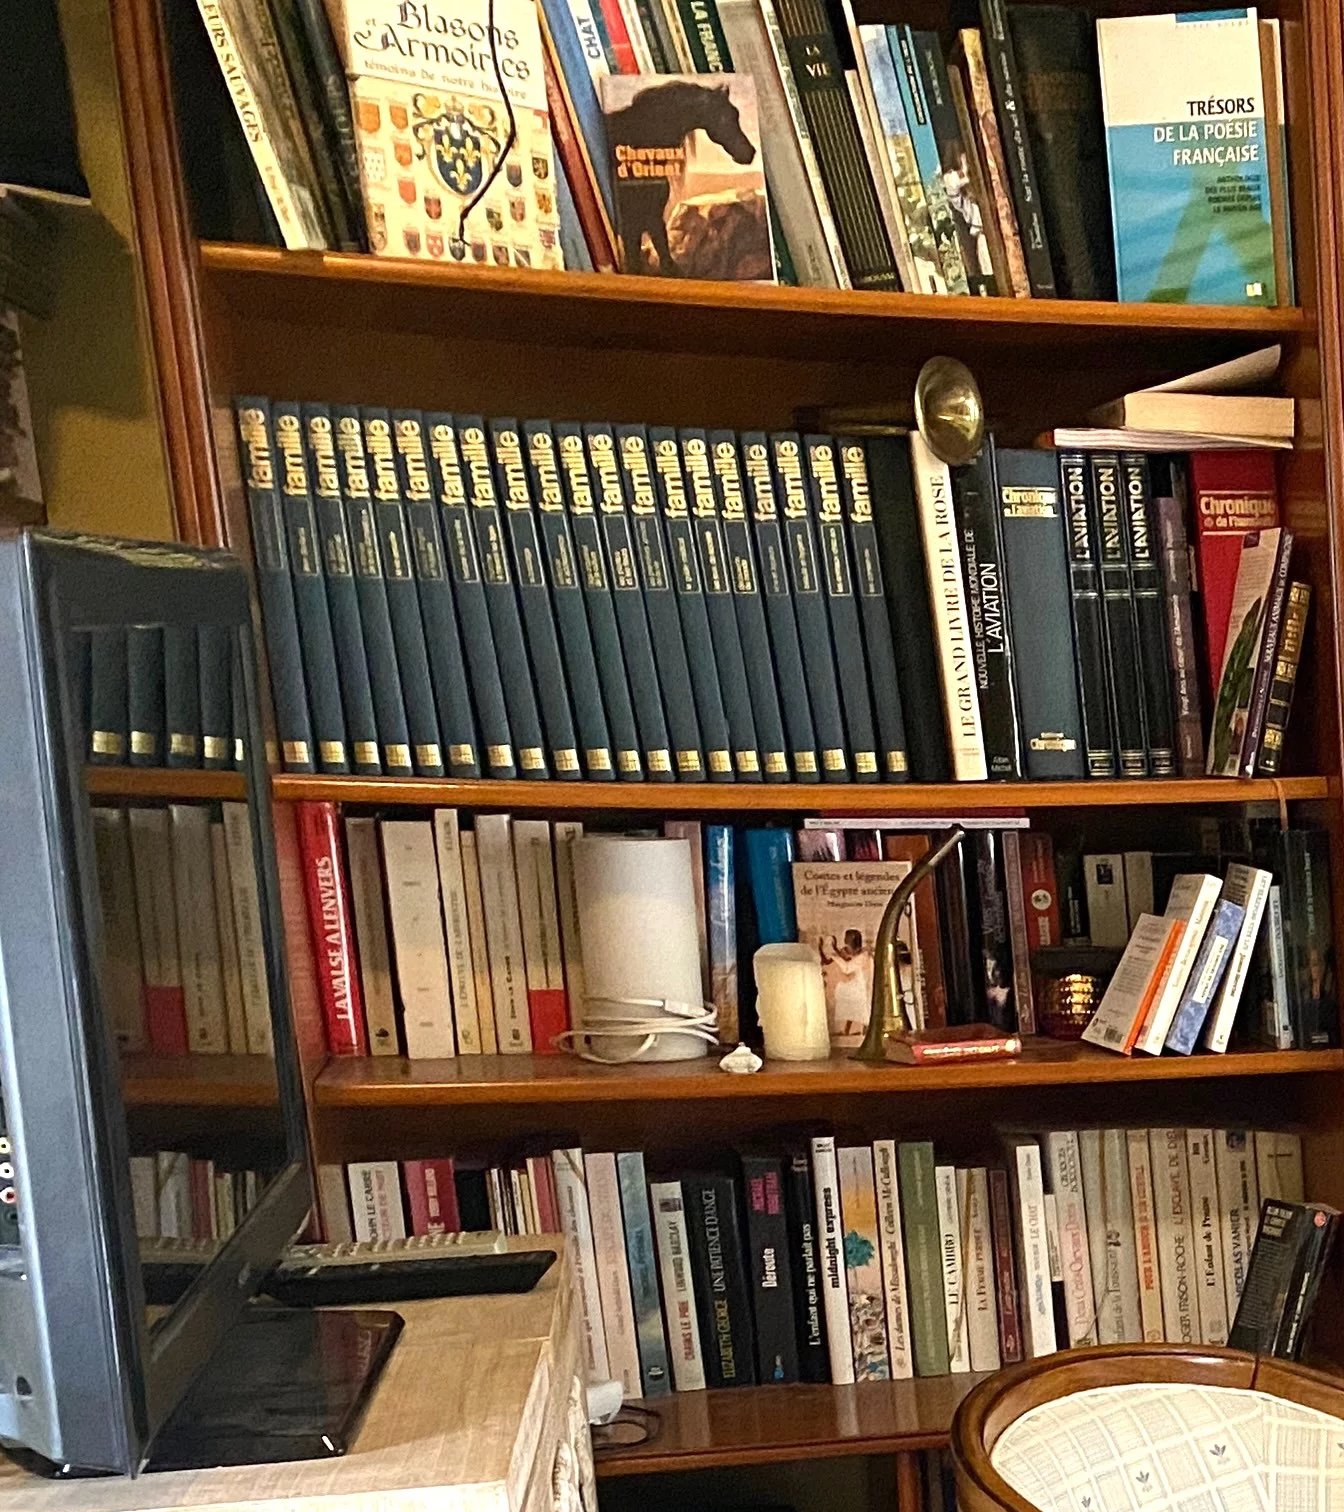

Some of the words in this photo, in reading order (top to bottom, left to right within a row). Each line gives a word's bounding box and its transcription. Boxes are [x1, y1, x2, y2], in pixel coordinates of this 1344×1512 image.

[397, 0, 519, 50] Blasons
[577, 16, 600, 60] CHAT
[1154, 124, 1175, 142] DE
[1179, 123, 1200, 141] LA
[1204, 118, 1258, 141] POÉSIE
[1187, 98, 1255, 116] TRÉSORS
[615, 145, 685, 161] Chevaux
[617, 161, 683, 180] d'Orient
[1173, 146, 1260, 169] FRANÇAISE
[238, 408, 274, 489] famille
[275, 415, 308, 495] famille
[308, 416, 340, 498] famille
[337, 417, 370, 499] famille
[366, 419, 399, 501] famille
[395, 419, 431, 501] famille
[430, 424, 465, 505] famille
[462, 428, 496, 508] famille
[496, 431, 531, 511] famille
[529, 432, 564, 512] famille
[591, 434, 624, 513] famille
[560, 436, 593, 515] famille
[623, 436, 655, 514] famille
[656, 440, 688, 518] famille
[684, 439, 716, 518] famille
[712, 442, 745, 520] famille
[744, 444, 777, 521] famille
[778, 441, 808, 518] famille
[811, 445, 841, 522] famille
[840, 447, 874, 522] famille
[930, 476, 948, 525] ROSE
[1067, 467, 1090, 559] L'AVIATION
[1098, 467, 1121, 559] L'AVIATION
[1128, 467, 1150, 559] L'AVIATION
[1200, 497, 1276, 517] Chronique
[938, 532, 951, 553] LA
[964, 529, 975, 543] DE
[942, 557, 956, 582] DE
[966, 546, 980, 594] MONDIALE
[945, 588, 964, 642] LIVRE
[970, 596, 984, 638] HISTOIRE
[980, 562, 1004, 653] L'AVIATION
[952, 647, 971, 712] GRAND
[975, 640, 989, 689] NOUVELLE
[962, 716, 976, 737] LE
[804, 870, 840, 880] Contes
[856, 871, 900, 882] légendes
[802, 1223, 814, 1240] pas
[821, 1187, 836, 1233] express
[1028, 1204, 1038, 1227] CHAT
[1030, 1229, 1039, 1239] LE
[705, 1227, 723, 1269] PATIENCE
[824, 1236, 840, 1288] midnight
[710, 1270, 725, 1292] UNE
[805, 1289, 818, 1304] qui
[713, 1299, 729, 1332] GEORGE
[806, 1306, 820, 1346] L'enfant
